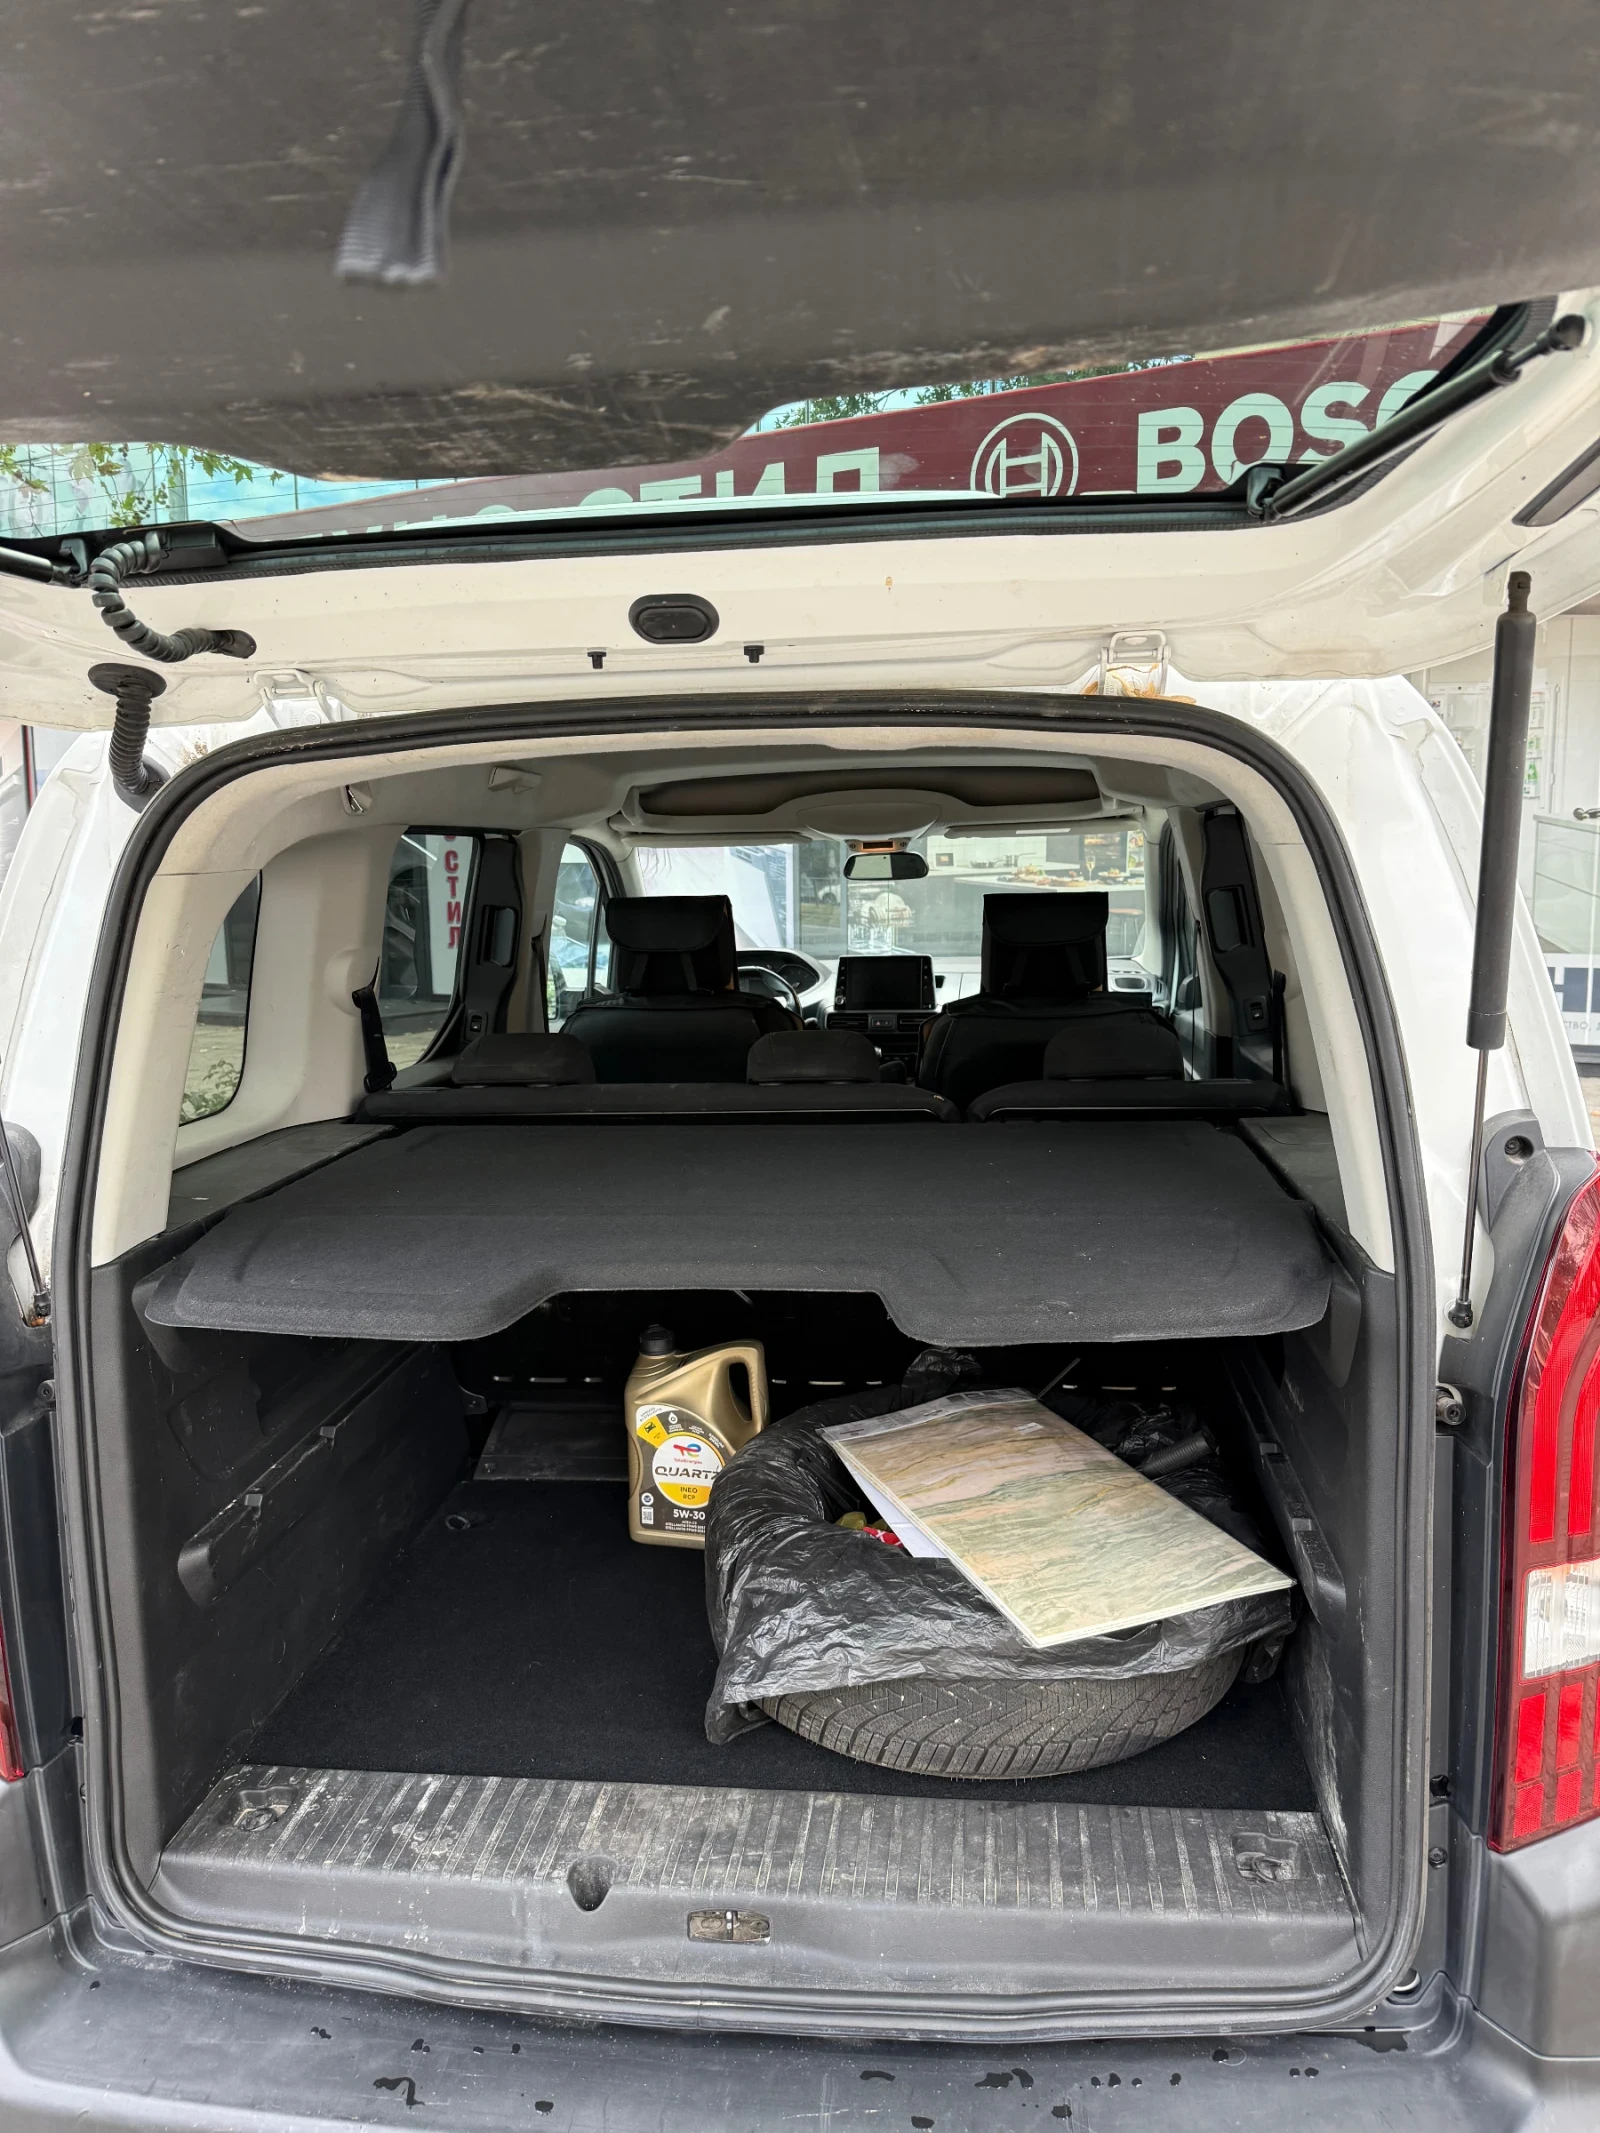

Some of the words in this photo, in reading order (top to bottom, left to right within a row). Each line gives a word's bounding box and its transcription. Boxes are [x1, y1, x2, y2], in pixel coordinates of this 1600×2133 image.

[444, 850, 461, 949] СТИЛ
[680, 1486, 698, 1494] INEO
[673, 1509, 706, 1520] 5W-30
